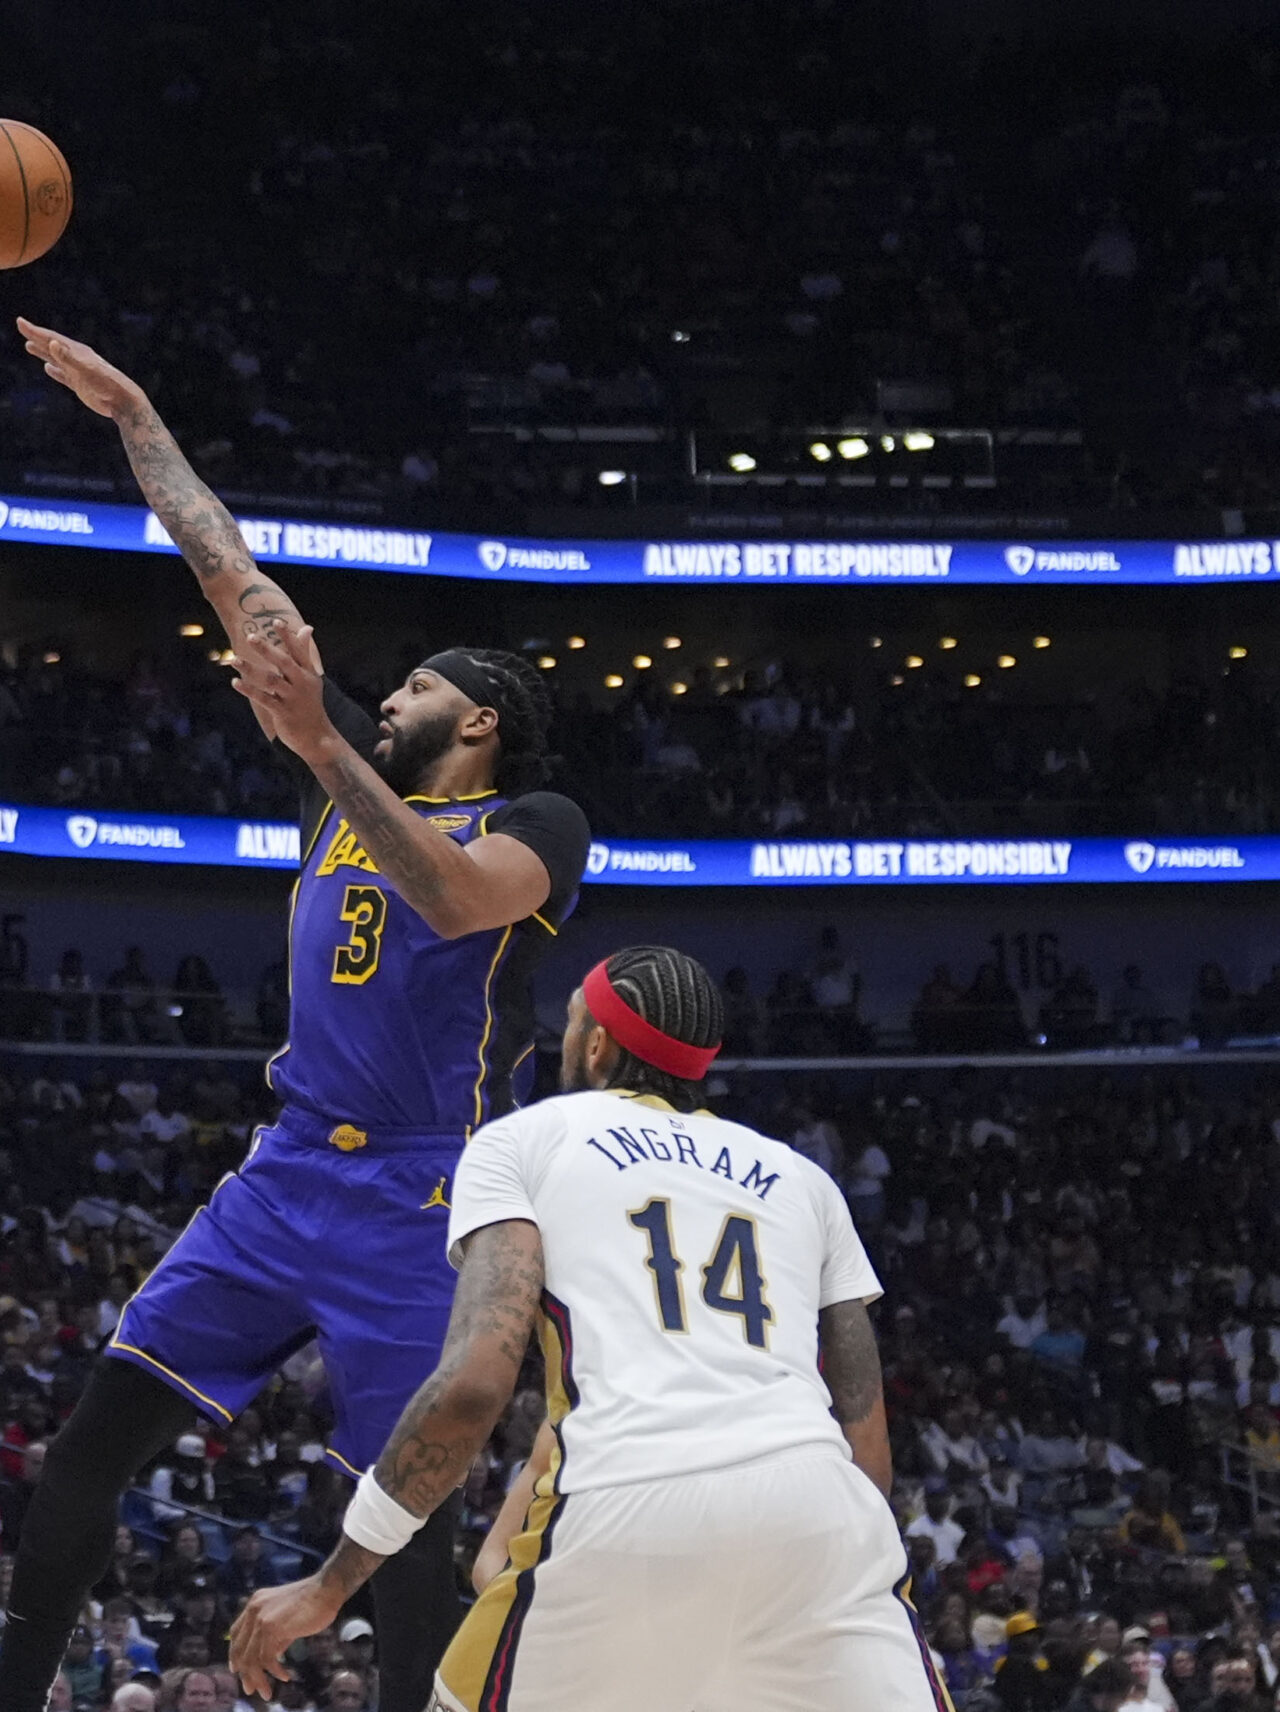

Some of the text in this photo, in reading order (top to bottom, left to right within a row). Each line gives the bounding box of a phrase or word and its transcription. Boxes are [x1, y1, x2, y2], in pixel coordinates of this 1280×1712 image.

[6, 505, 94, 534] FANDUEL
[283, 523, 432, 567] RESPONSIBLY
[507, 548, 591, 571] FANDUEL
[643, 543, 953, 577] ALWAYS BET RESPONSIBLY
[1035, 551, 1121, 572] FANDUEL
[1174, 542, 1272, 577] ALWAYS
[97, 824, 186, 849] FANDUEL
[236, 824, 301, 861] ALWA
[610, 850, 696, 872] FANDUEL
[751, 842, 1071, 877] ALWAYS BET RESPONSIBLY
[1155, 848, 1244, 868] FANDUEL
[331, 885, 388, 985] 3
[587, 1126, 781, 1201] INGRAM
[626, 1196, 776, 1353] 14
